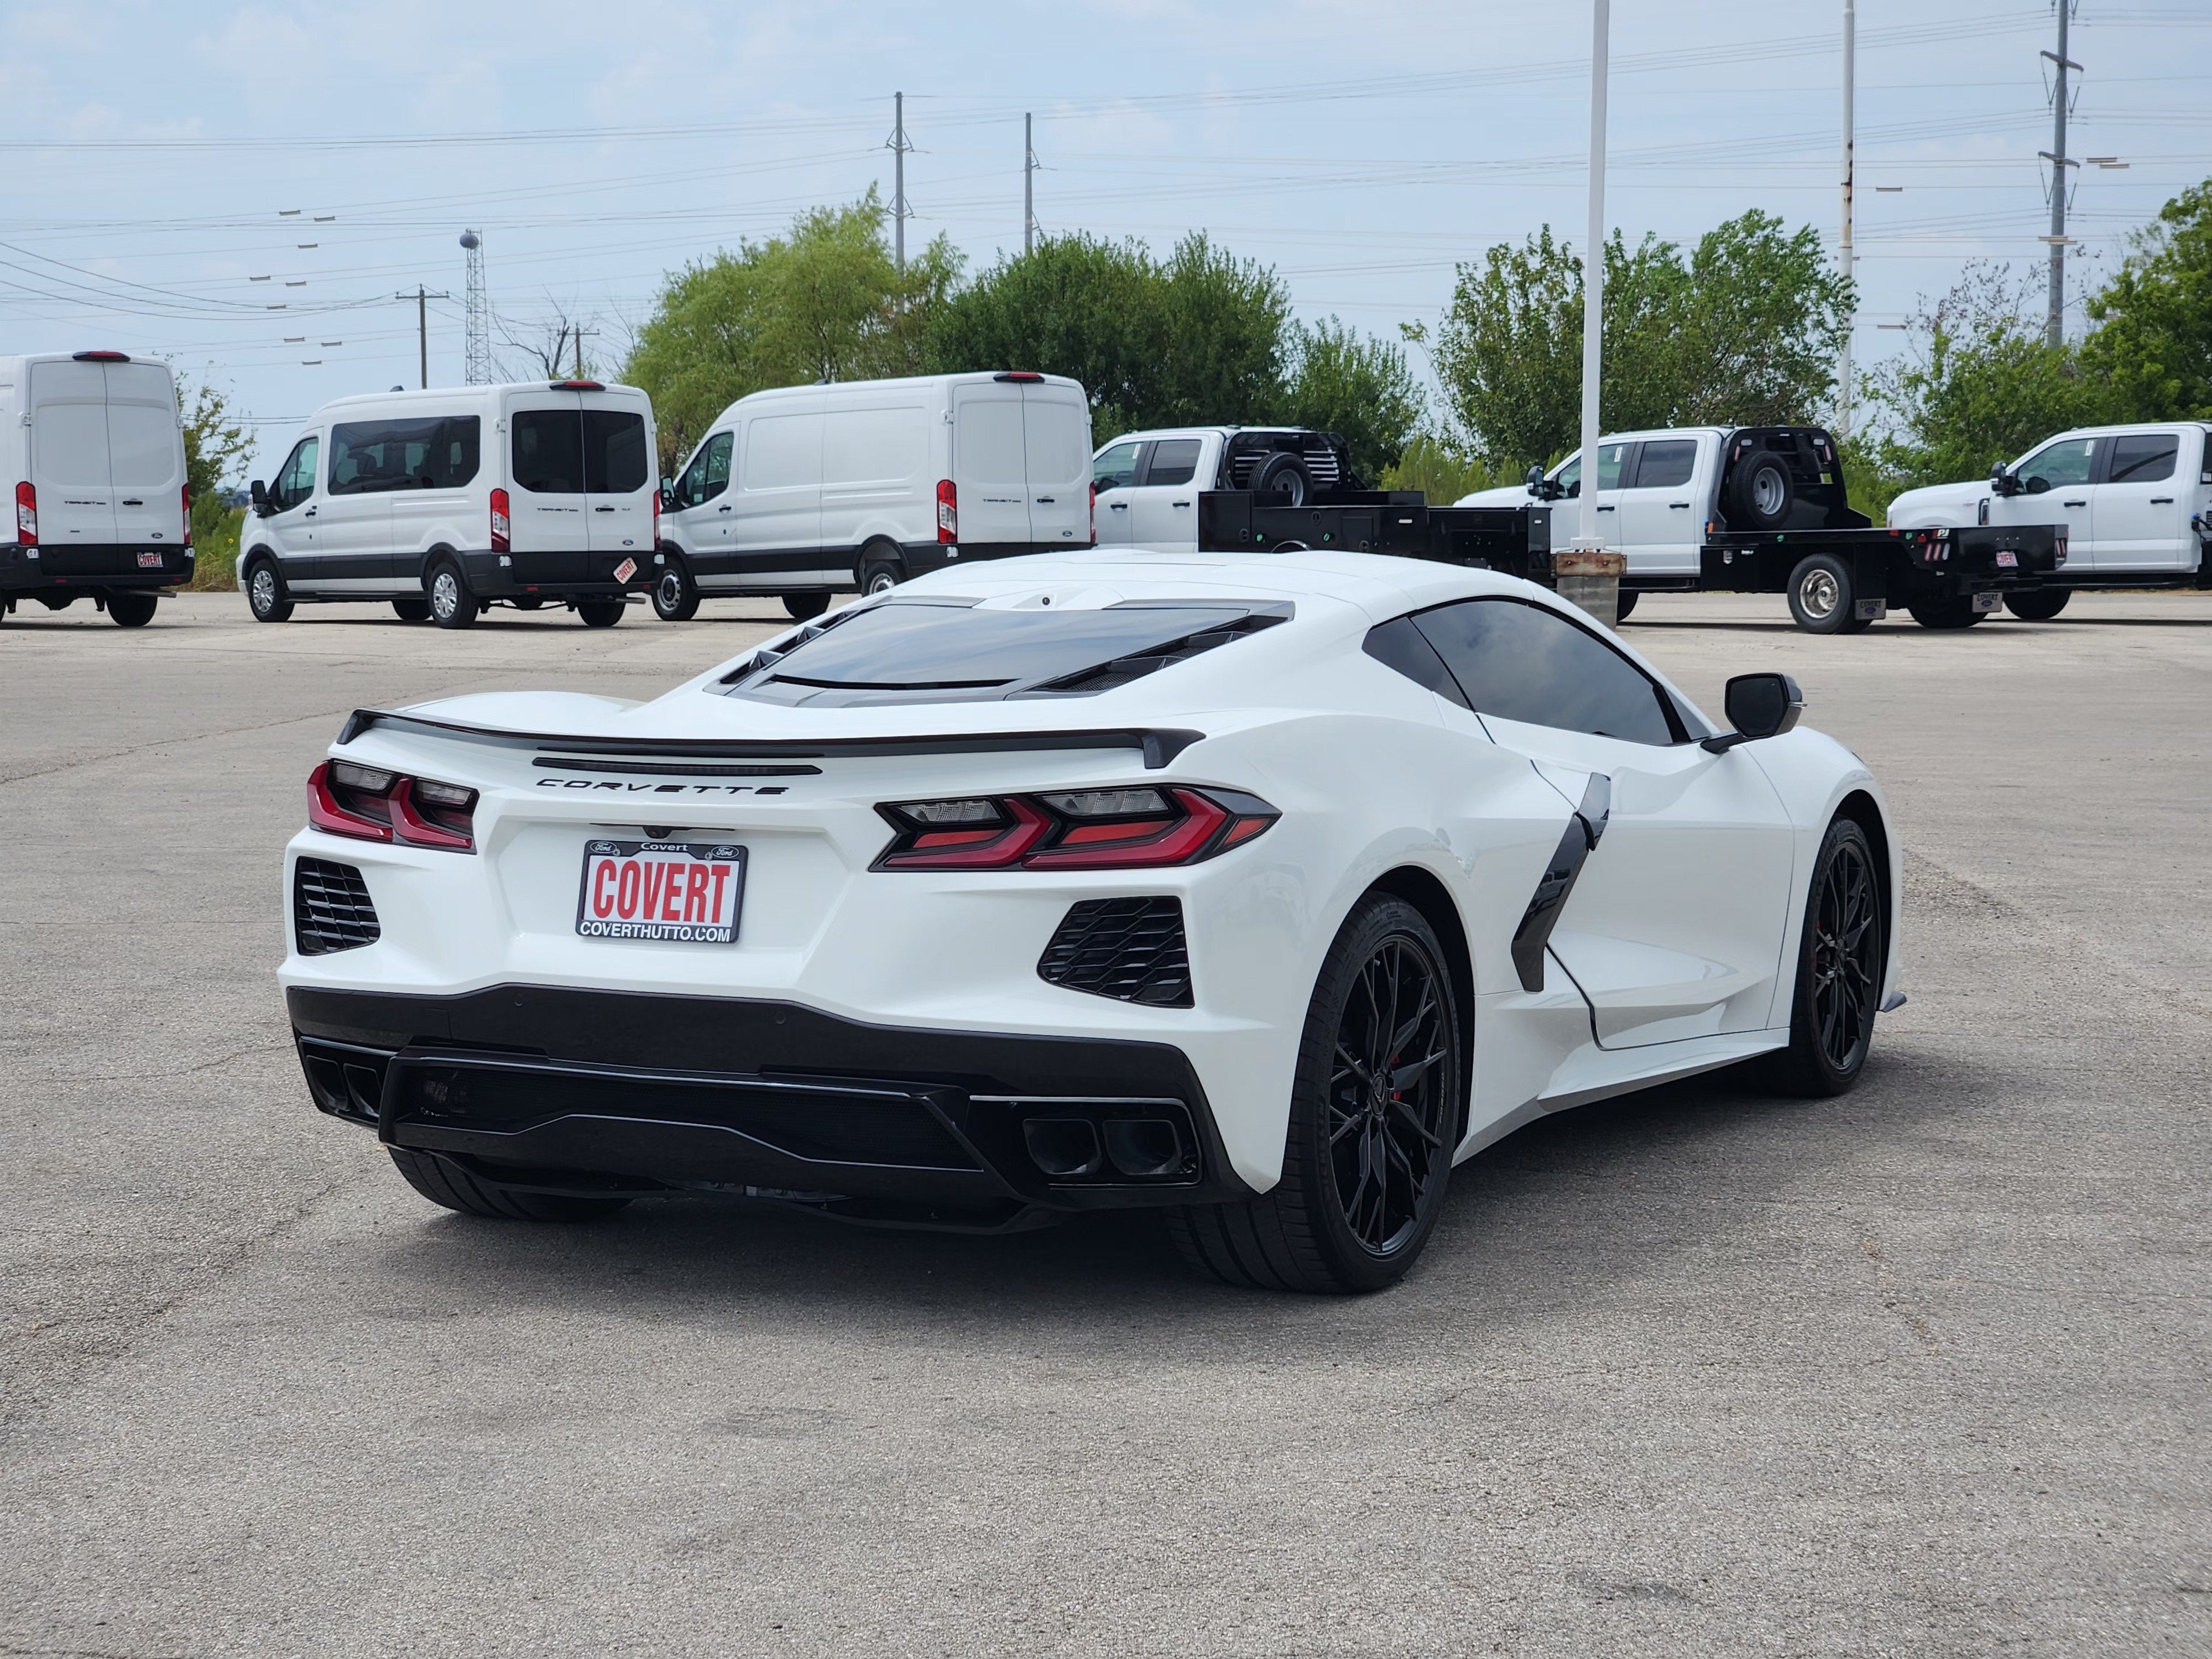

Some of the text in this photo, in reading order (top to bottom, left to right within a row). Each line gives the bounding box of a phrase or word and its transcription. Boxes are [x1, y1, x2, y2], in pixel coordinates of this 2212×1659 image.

[139, 555, 160, 565] COVERT
[617, 560, 634, 581] COVERT
[536, 779, 790, 794] CORVETTE
[641, 842, 688, 851] Covert
[593, 859, 731, 923] COVERT
[580, 921, 730, 942] COVERTHUTTO.COM
